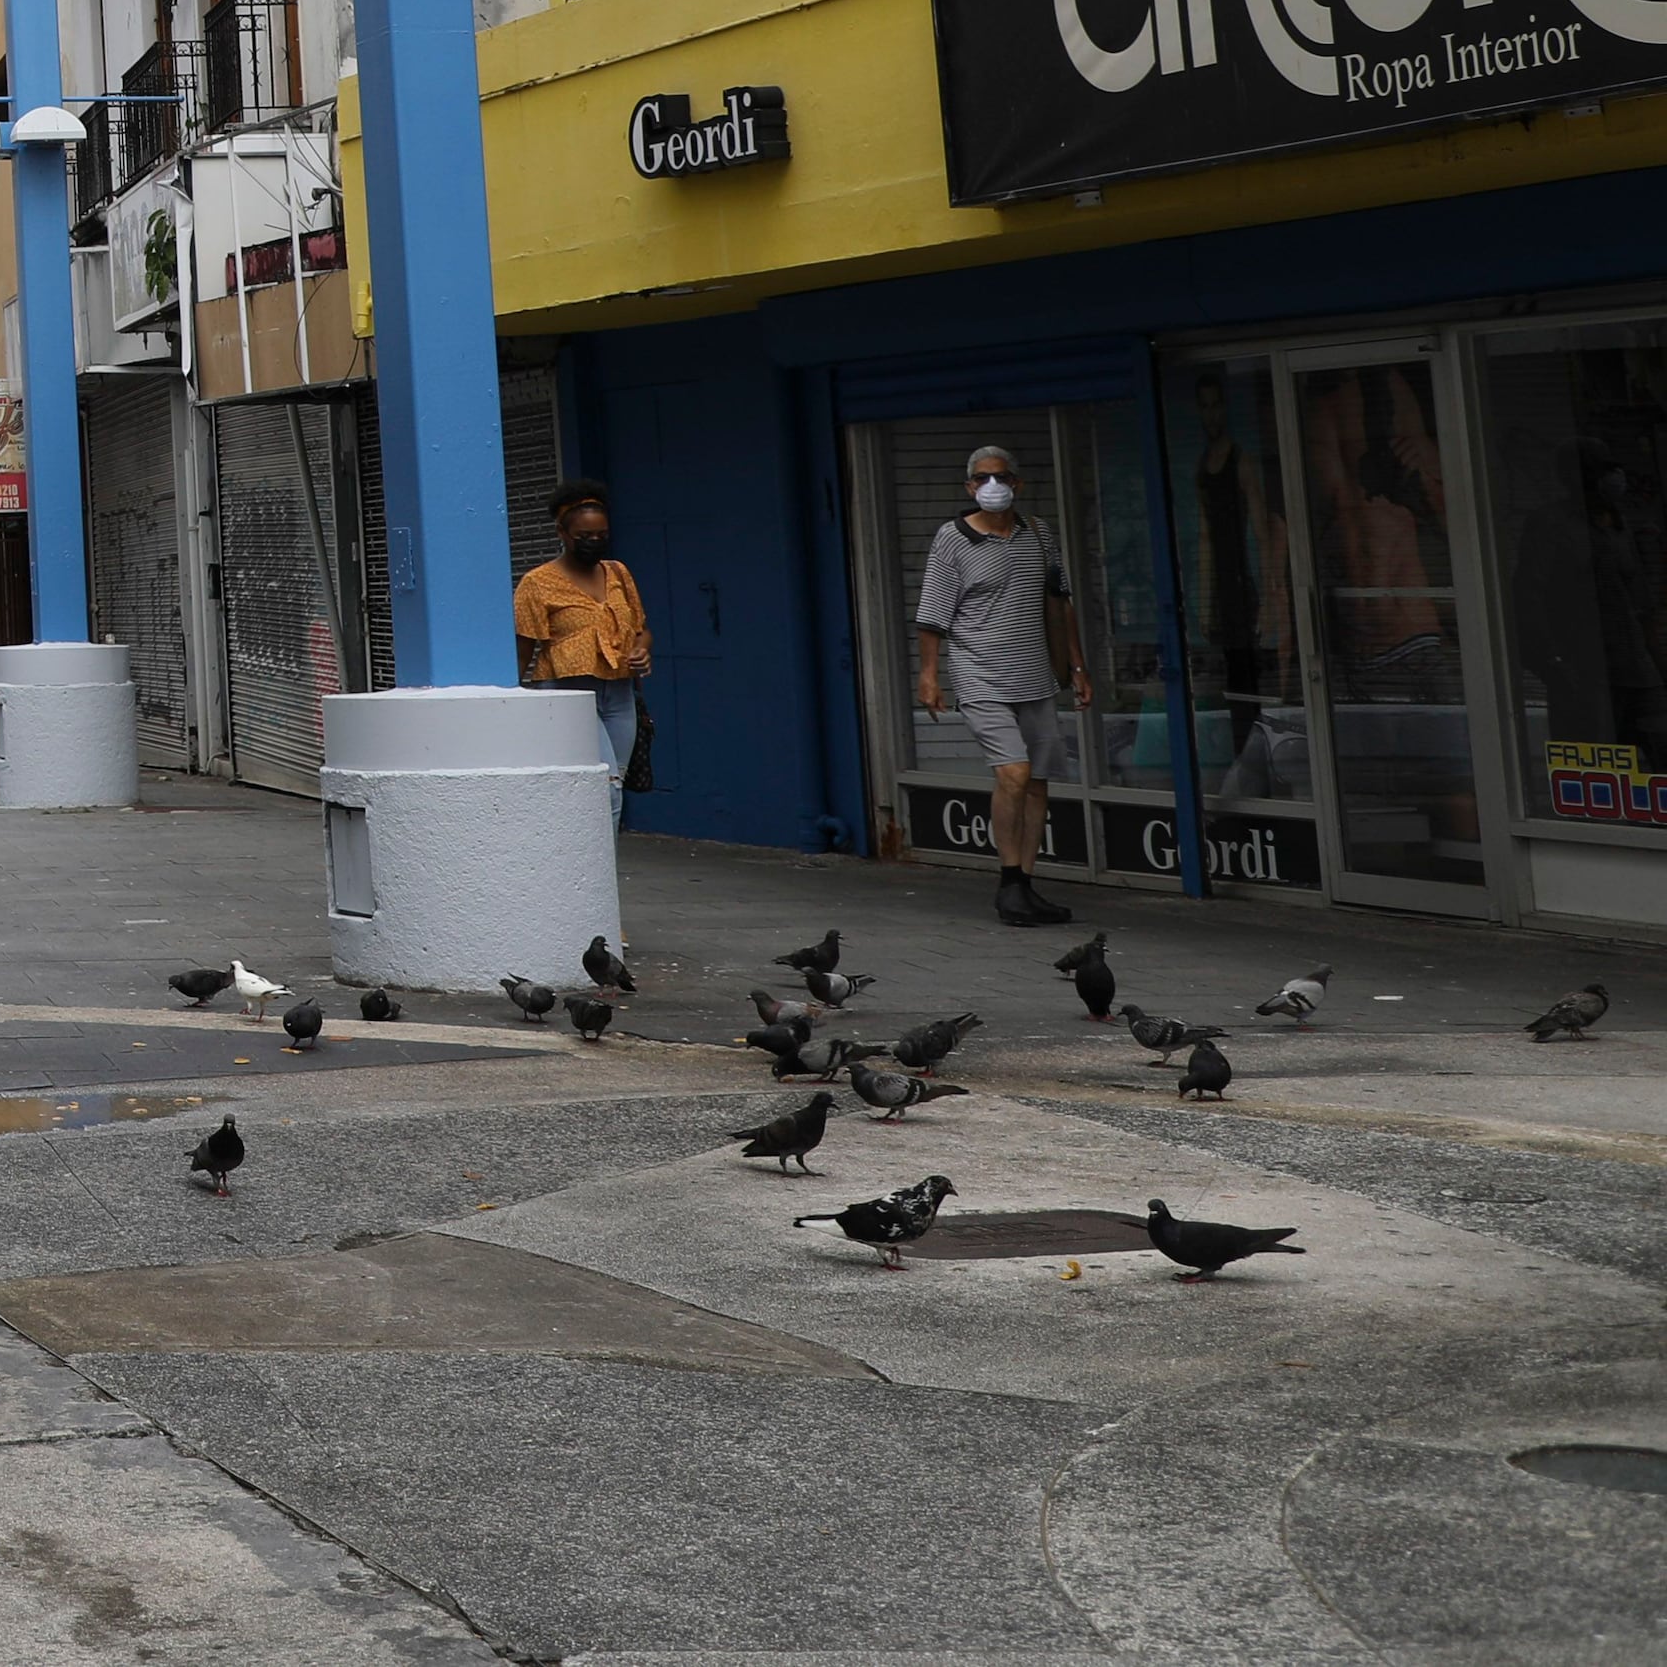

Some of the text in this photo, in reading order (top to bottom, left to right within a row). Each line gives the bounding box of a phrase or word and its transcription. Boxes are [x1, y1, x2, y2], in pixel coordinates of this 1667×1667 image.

[1342, 14, 1582, 109] Ropa Interior
[632, 91, 758, 174] Geordi
[1547, 744, 1632, 770] FAJAS
[942, 798, 1057, 857] Gei
[1142, 819, 1281, 880] Gordi
